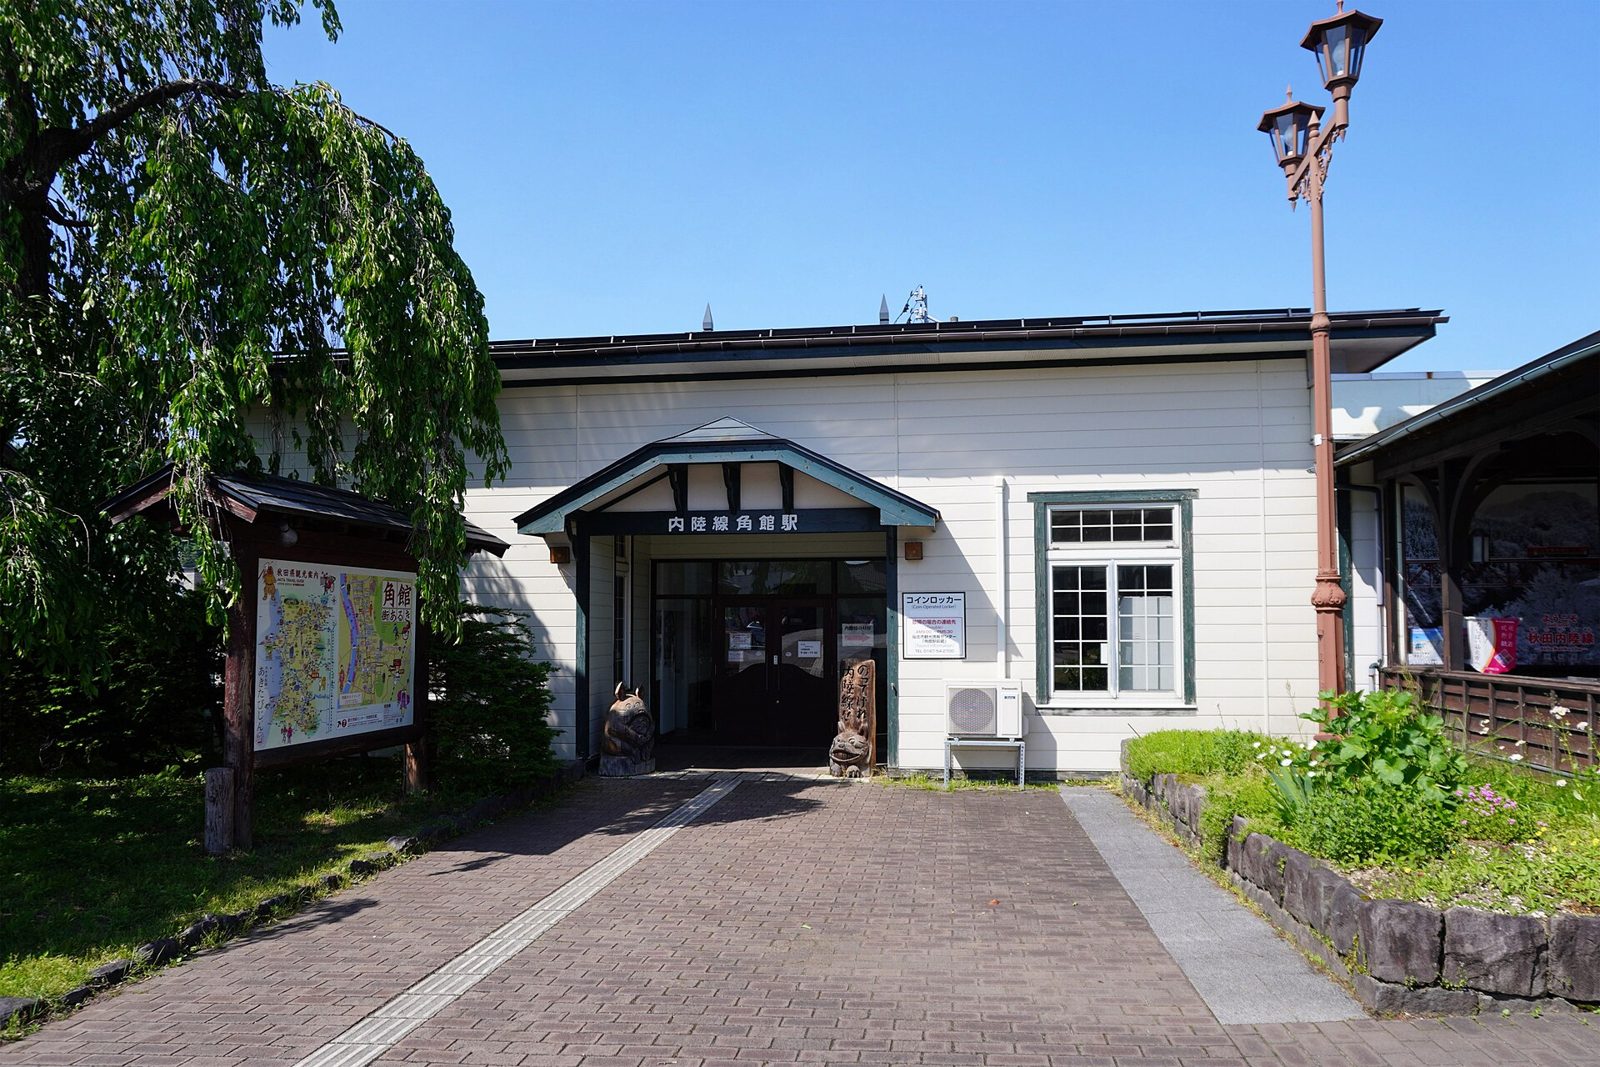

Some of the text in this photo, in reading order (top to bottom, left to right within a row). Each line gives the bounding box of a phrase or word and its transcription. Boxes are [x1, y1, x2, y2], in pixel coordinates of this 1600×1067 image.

[668, 514, 798, 532] 内陸線角館駅
[383, 581, 412, 608] 角館
[906, 596, 962, 604] コインロッカー
[382, 609, 410, 622] 街あるき
